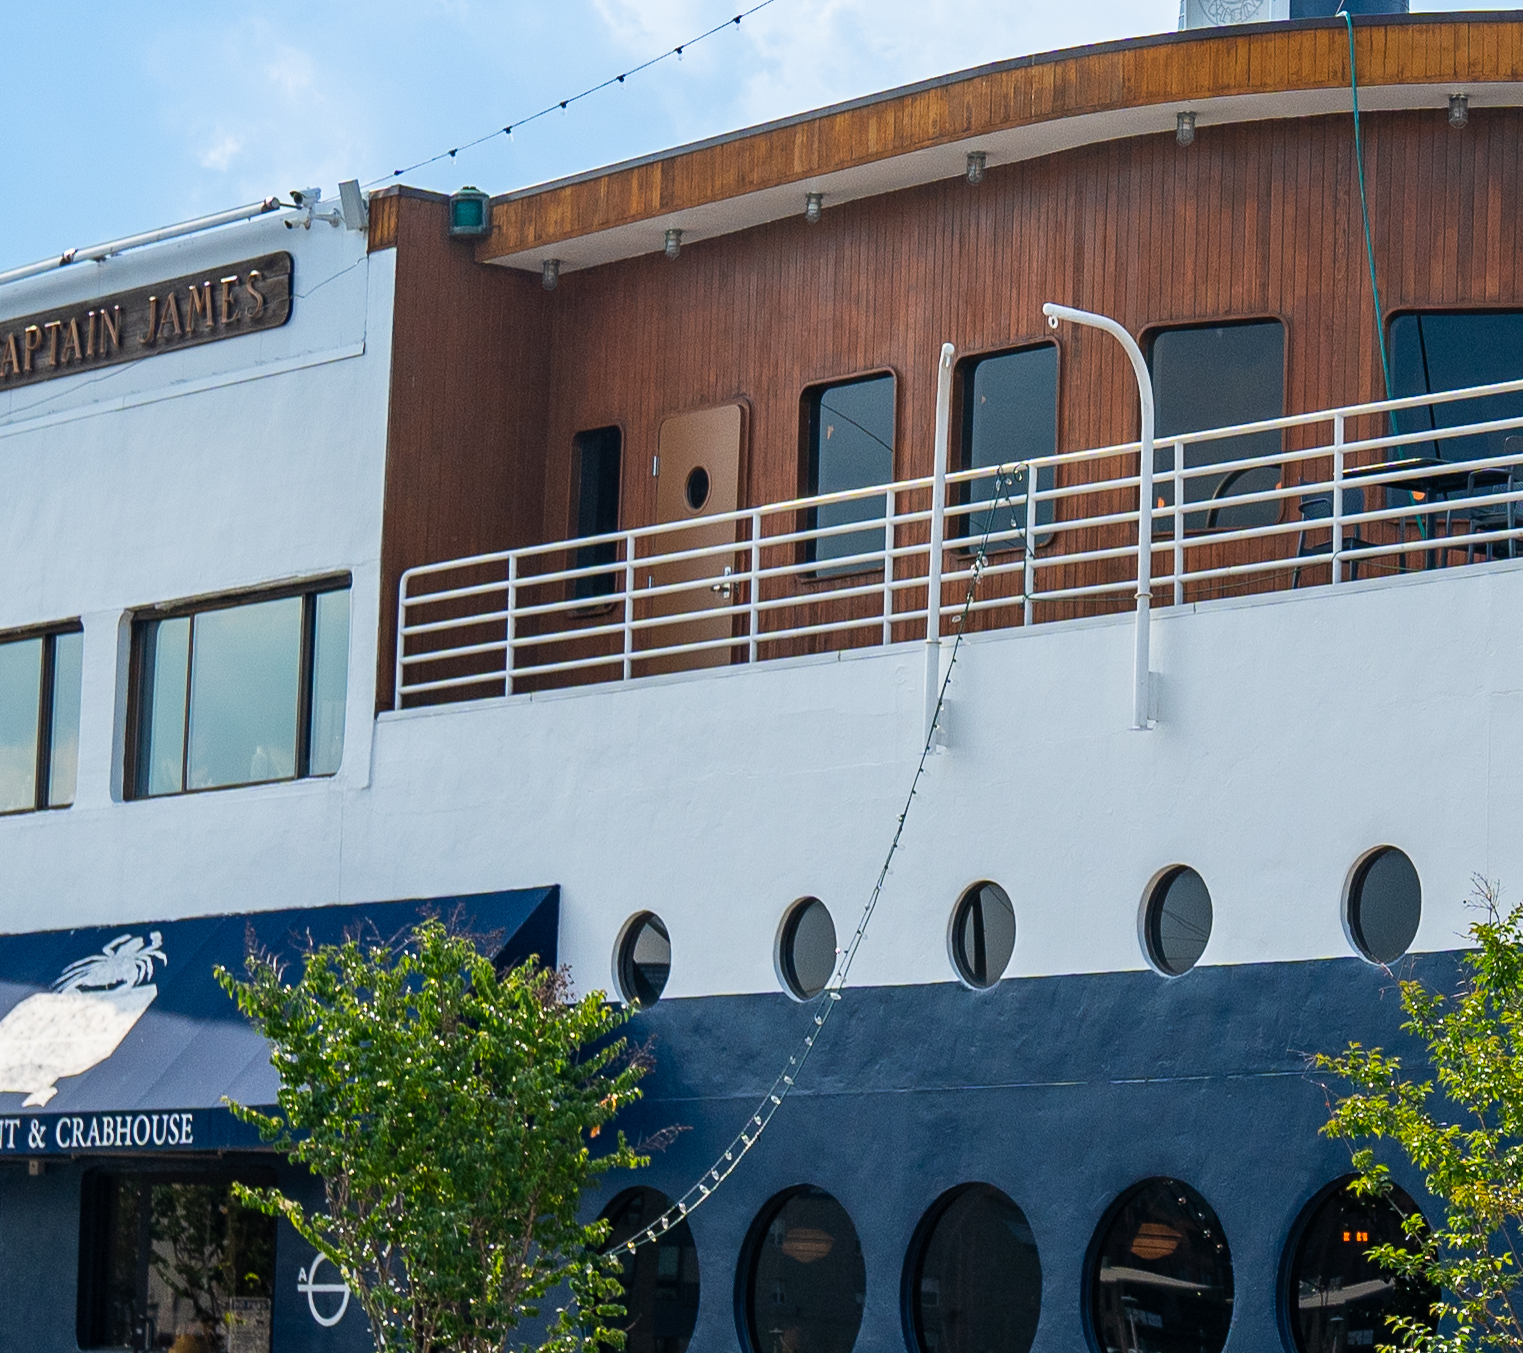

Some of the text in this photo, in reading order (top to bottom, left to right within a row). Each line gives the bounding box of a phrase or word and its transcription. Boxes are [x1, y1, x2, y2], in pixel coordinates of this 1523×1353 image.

[138, 270, 263, 344] JAMES
[28, 1119, 47, 1149] &
[55, 1114, 194, 1148] CRABHOUSE
[298, 1267, 308, 1282] A
